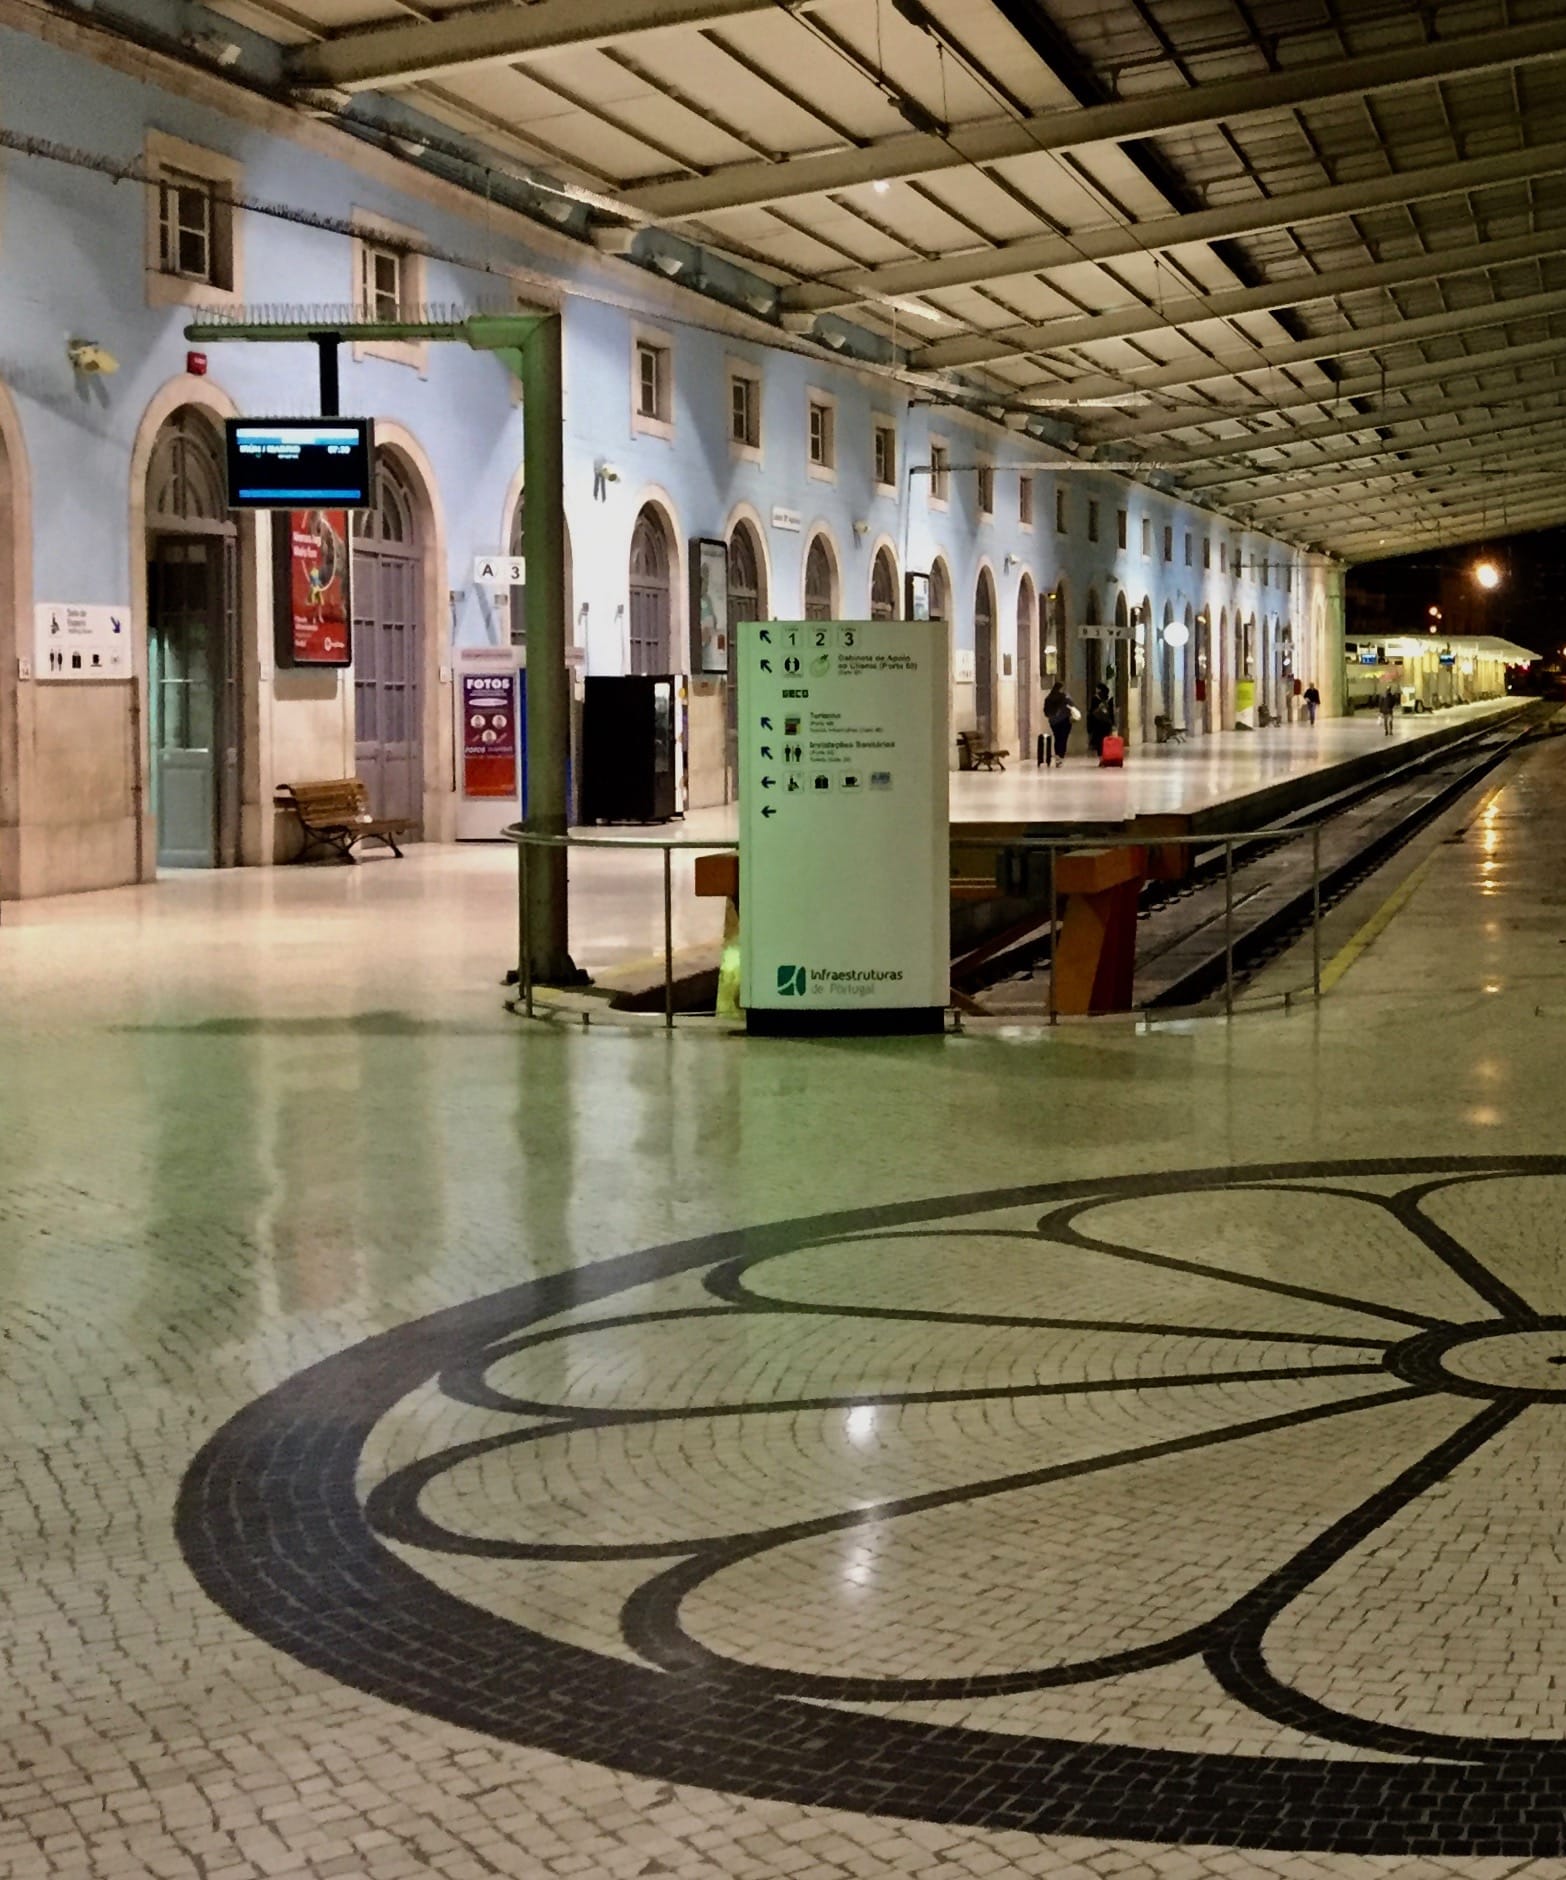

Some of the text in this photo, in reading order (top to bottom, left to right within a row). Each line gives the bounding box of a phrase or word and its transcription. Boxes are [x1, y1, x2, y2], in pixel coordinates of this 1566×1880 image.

[482, 564, 520, 579] A 3
[788, 632, 854, 646] 1 2 3
[466, 678, 510, 690] FOTOS
[811, 969, 903, 981] Infraestruturas
[811, 984, 875, 997] de Portugal
